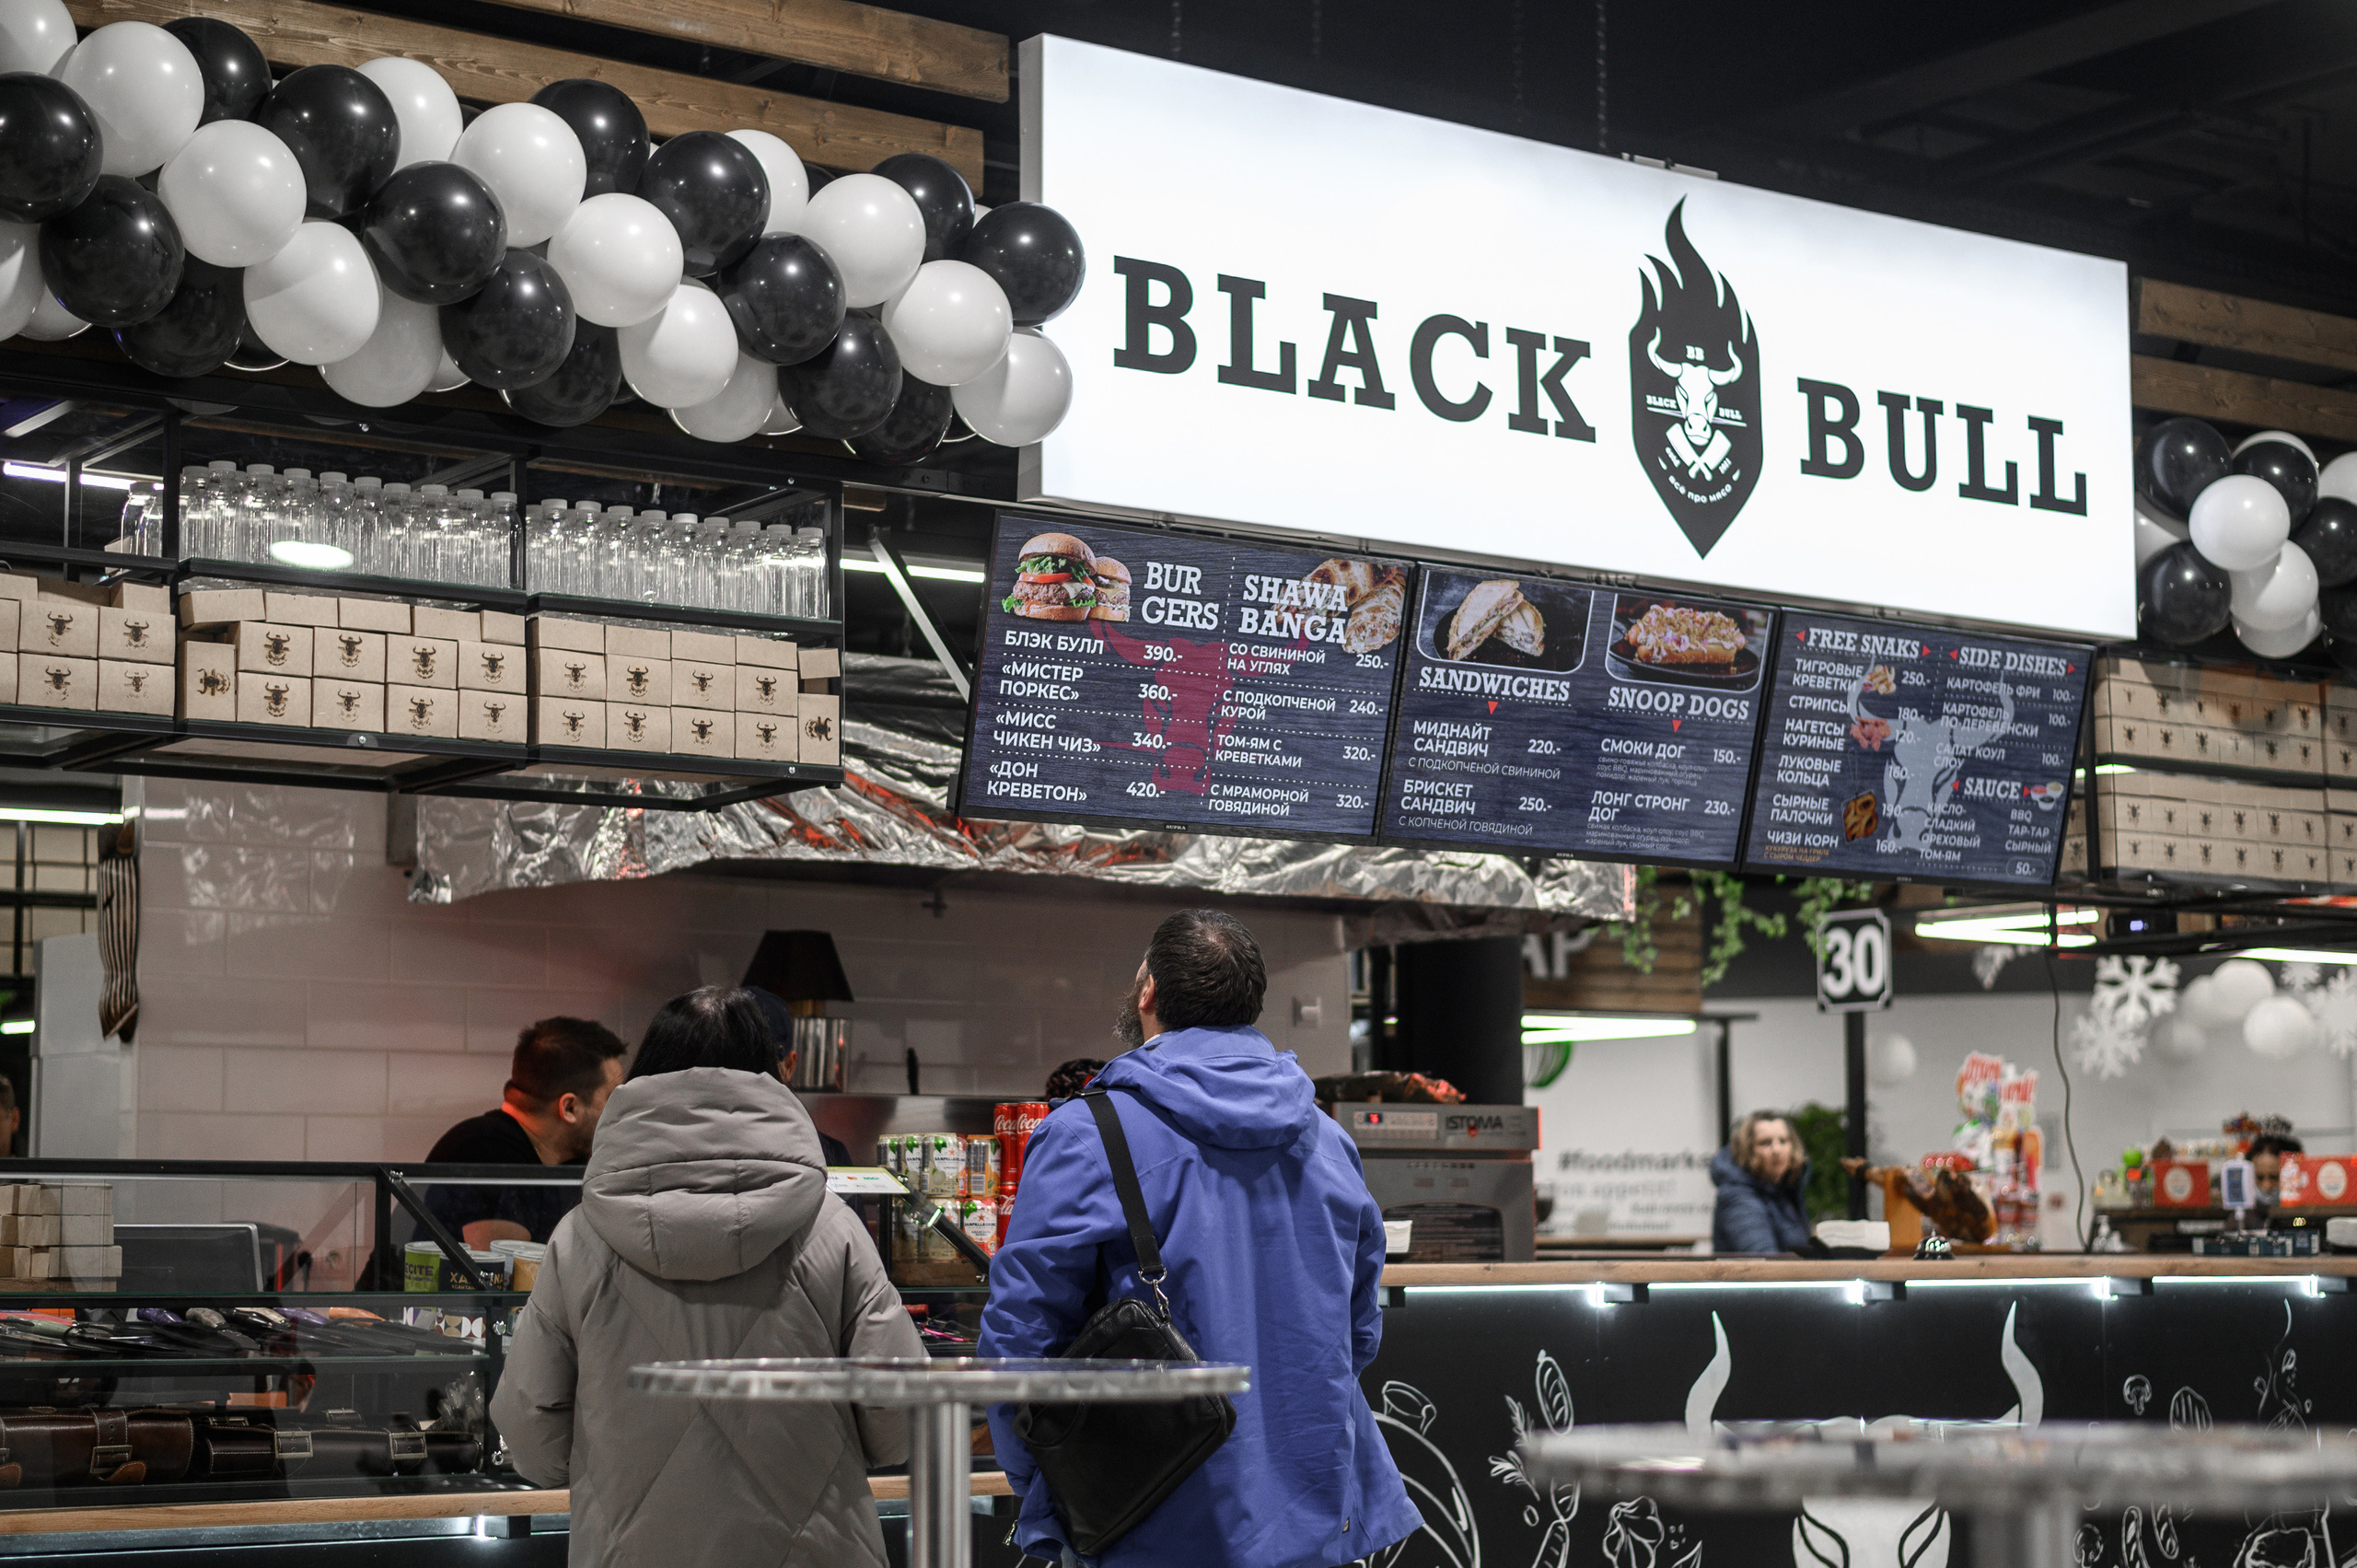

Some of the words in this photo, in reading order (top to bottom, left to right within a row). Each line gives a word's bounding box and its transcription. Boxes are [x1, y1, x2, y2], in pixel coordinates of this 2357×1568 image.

[1686, 345, 1704, 361] BB
[1113, 255, 1596, 443] BLACK
[1797, 376, 2087, 517] BULL
[1646, 395, 1677, 409] BLACK
[1719, 407, 1742, 420] BULL
[1144, 562, 1202, 595] BUR
[1243, 575, 1348, 611] SHAWA
[1141, 596, 1219, 630] GERS
[1238, 607, 1347, 644] BANGA
[1005, 631, 1051, 650] БЛЭК
[1057, 635, 1104, 655] БУЛЛ
[1807, 627, 1858, 651] FREE
[1861, 637, 1920, 658] SNAKS
[1144, 645, 1183, 663] 390.-
[1229, 643, 1247, 656] СО
[1250, 644, 1326, 664] СВИНИНОЙ
[1355, 654, 1388, 669] 250.-
[1959, 646, 2002, 668] SIDE
[2004, 653, 2067, 676] DISHES
[1002, 662, 1084, 683] «МИСТЕР
[1227, 657, 1247, 671] НА
[1249, 660, 1290, 676] УГЛЯХ
[1796, 658, 1864, 678] ТИГРОВЫЕ
[1419, 667, 1570, 702] SANDWICHES
[1793, 674, 1857, 691] КРЕВЕТКИ
[1901, 671, 1931, 686] 250.-
[1000, 680, 1079, 701] ПОРКЕС»
[1138, 684, 1178, 701] 360.-
[1947, 677, 2014, 695] КАРТОФЕЛЬ
[2016, 686, 2040, 699] ФРИ
[2053, 689, 2074, 702] 100.-
[1223, 691, 1232, 703] С
[1235, 691, 1336, 713] ПОДКОПЧЕНОЙ
[1349, 700, 1383, 716] 240.-
[1608, 687, 1684, 714] SNOOP
[1688, 696, 1749, 719] DOGS
[1789, 696, 1851, 713] СТРИПСЫ
[1943, 702, 2009, 719] КАРТОФЕЛЬ
[995, 712, 1056, 729] «МИСС
[1221, 704, 1266, 721] КУРОЙ
[1898, 707, 1924, 722] 180.-
[2049, 714, 2071, 726] 100.-
[1413, 720, 1492, 741] МИДНАЙТ
[1785, 718, 1845, 736] НАГЕТСЫ
[1941, 716, 2038, 737] ПО-ДЕРЕВЕНСКИ
[993, 731, 1053, 750] ЧИКЕН
[1058, 736, 1101, 752] ЧИЗ»
[1132, 732, 1172, 749] 340.-
[1217, 735, 1270, 749] ТОМ-ЯМ
[1272, 738, 1282, 750] С
[1414, 738, 1489, 757] САНДВИЧ
[1527, 740, 1561, 754] 220.-
[1601, 738, 1652, 756] СМОКИ
[1655, 743, 1685, 760] ДОГ
[1783, 734, 1844, 750] КУРИНЫЕ
[1215, 750, 1302, 768] КРЕВЕТКАМИ
[1342, 746, 1376, 761] 320.-
[1713, 749, 1741, 764] 150.-
[1936, 743, 1973, 756] САЛАТ
[1975, 747, 2005, 760] КОУЛ
[2042, 753, 2064, 766] 100.-
[989, 761, 1038, 779] «ДОН
[1409, 758, 1415, 767] С
[1418, 759, 1500, 776] ПОДКОПЧЕНОЙ
[1502, 764, 1561, 780] СВИНИНОЙ
[1779, 755, 1841, 772] ЛУКОВЫЕ
[1934, 756, 1964, 769] СЛОУ
[1777, 770, 1829, 787] КОЛЬЦА
[987, 781, 1087, 801] КРЕВЕТОН»
[1126, 781, 1166, 797] 420.-
[1211, 784, 1219, 796] С
[1222, 786, 1308, 804] МРАМОРНОЙ
[1403, 780, 1473, 797] БРИСКЕТ
[1964, 777, 2021, 799] SAUCE
[1209, 799, 1290, 817] ГОВЯДИНОЙ
[1336, 795, 1369, 809] 320.-
[1401, 796, 1476, 815] САНДВИЧ
[1518, 797, 1551, 812] 250.-
[1591, 791, 1632, 807] ЛОНГ
[1634, 795, 1690, 811] СТРОНГ
[1704, 800, 1736, 815] 230.-
[1773, 794, 1829, 810] СЫРНЫЕ
[1927, 803, 1966, 815] КИСЛО-
[1588, 807, 1620, 822] ДОГ
[1771, 808, 1832, 825] ПАЛОЧКИ
[2011, 809, 2032, 822] BBQ
[1399, 816, 1406, 826] С
[1408, 817, 1467, 831] КОПЧЕНОЙ
[1469, 820, 1533, 836] ГОВЯДИНОЙ
[1924, 817, 1975, 830] СЛАДКИЙ
[2009, 825, 2049, 838] ТАР-ТАР
[1767, 830, 1802, 846] ЧИЗИ
[1804, 833, 1839, 848] КОРН
[1876, 840, 1902, 854] 160.-
[1921, 832, 1980, 847] ОРЕХОВЫЙ
[2005, 839, 2051, 853] СЫРНЫЙ
[1920, 849, 1960, 861] ТОМ-ЯМ
[2015, 862, 2036, 875] 50.-
[1821, 924, 1884, 998] 30
